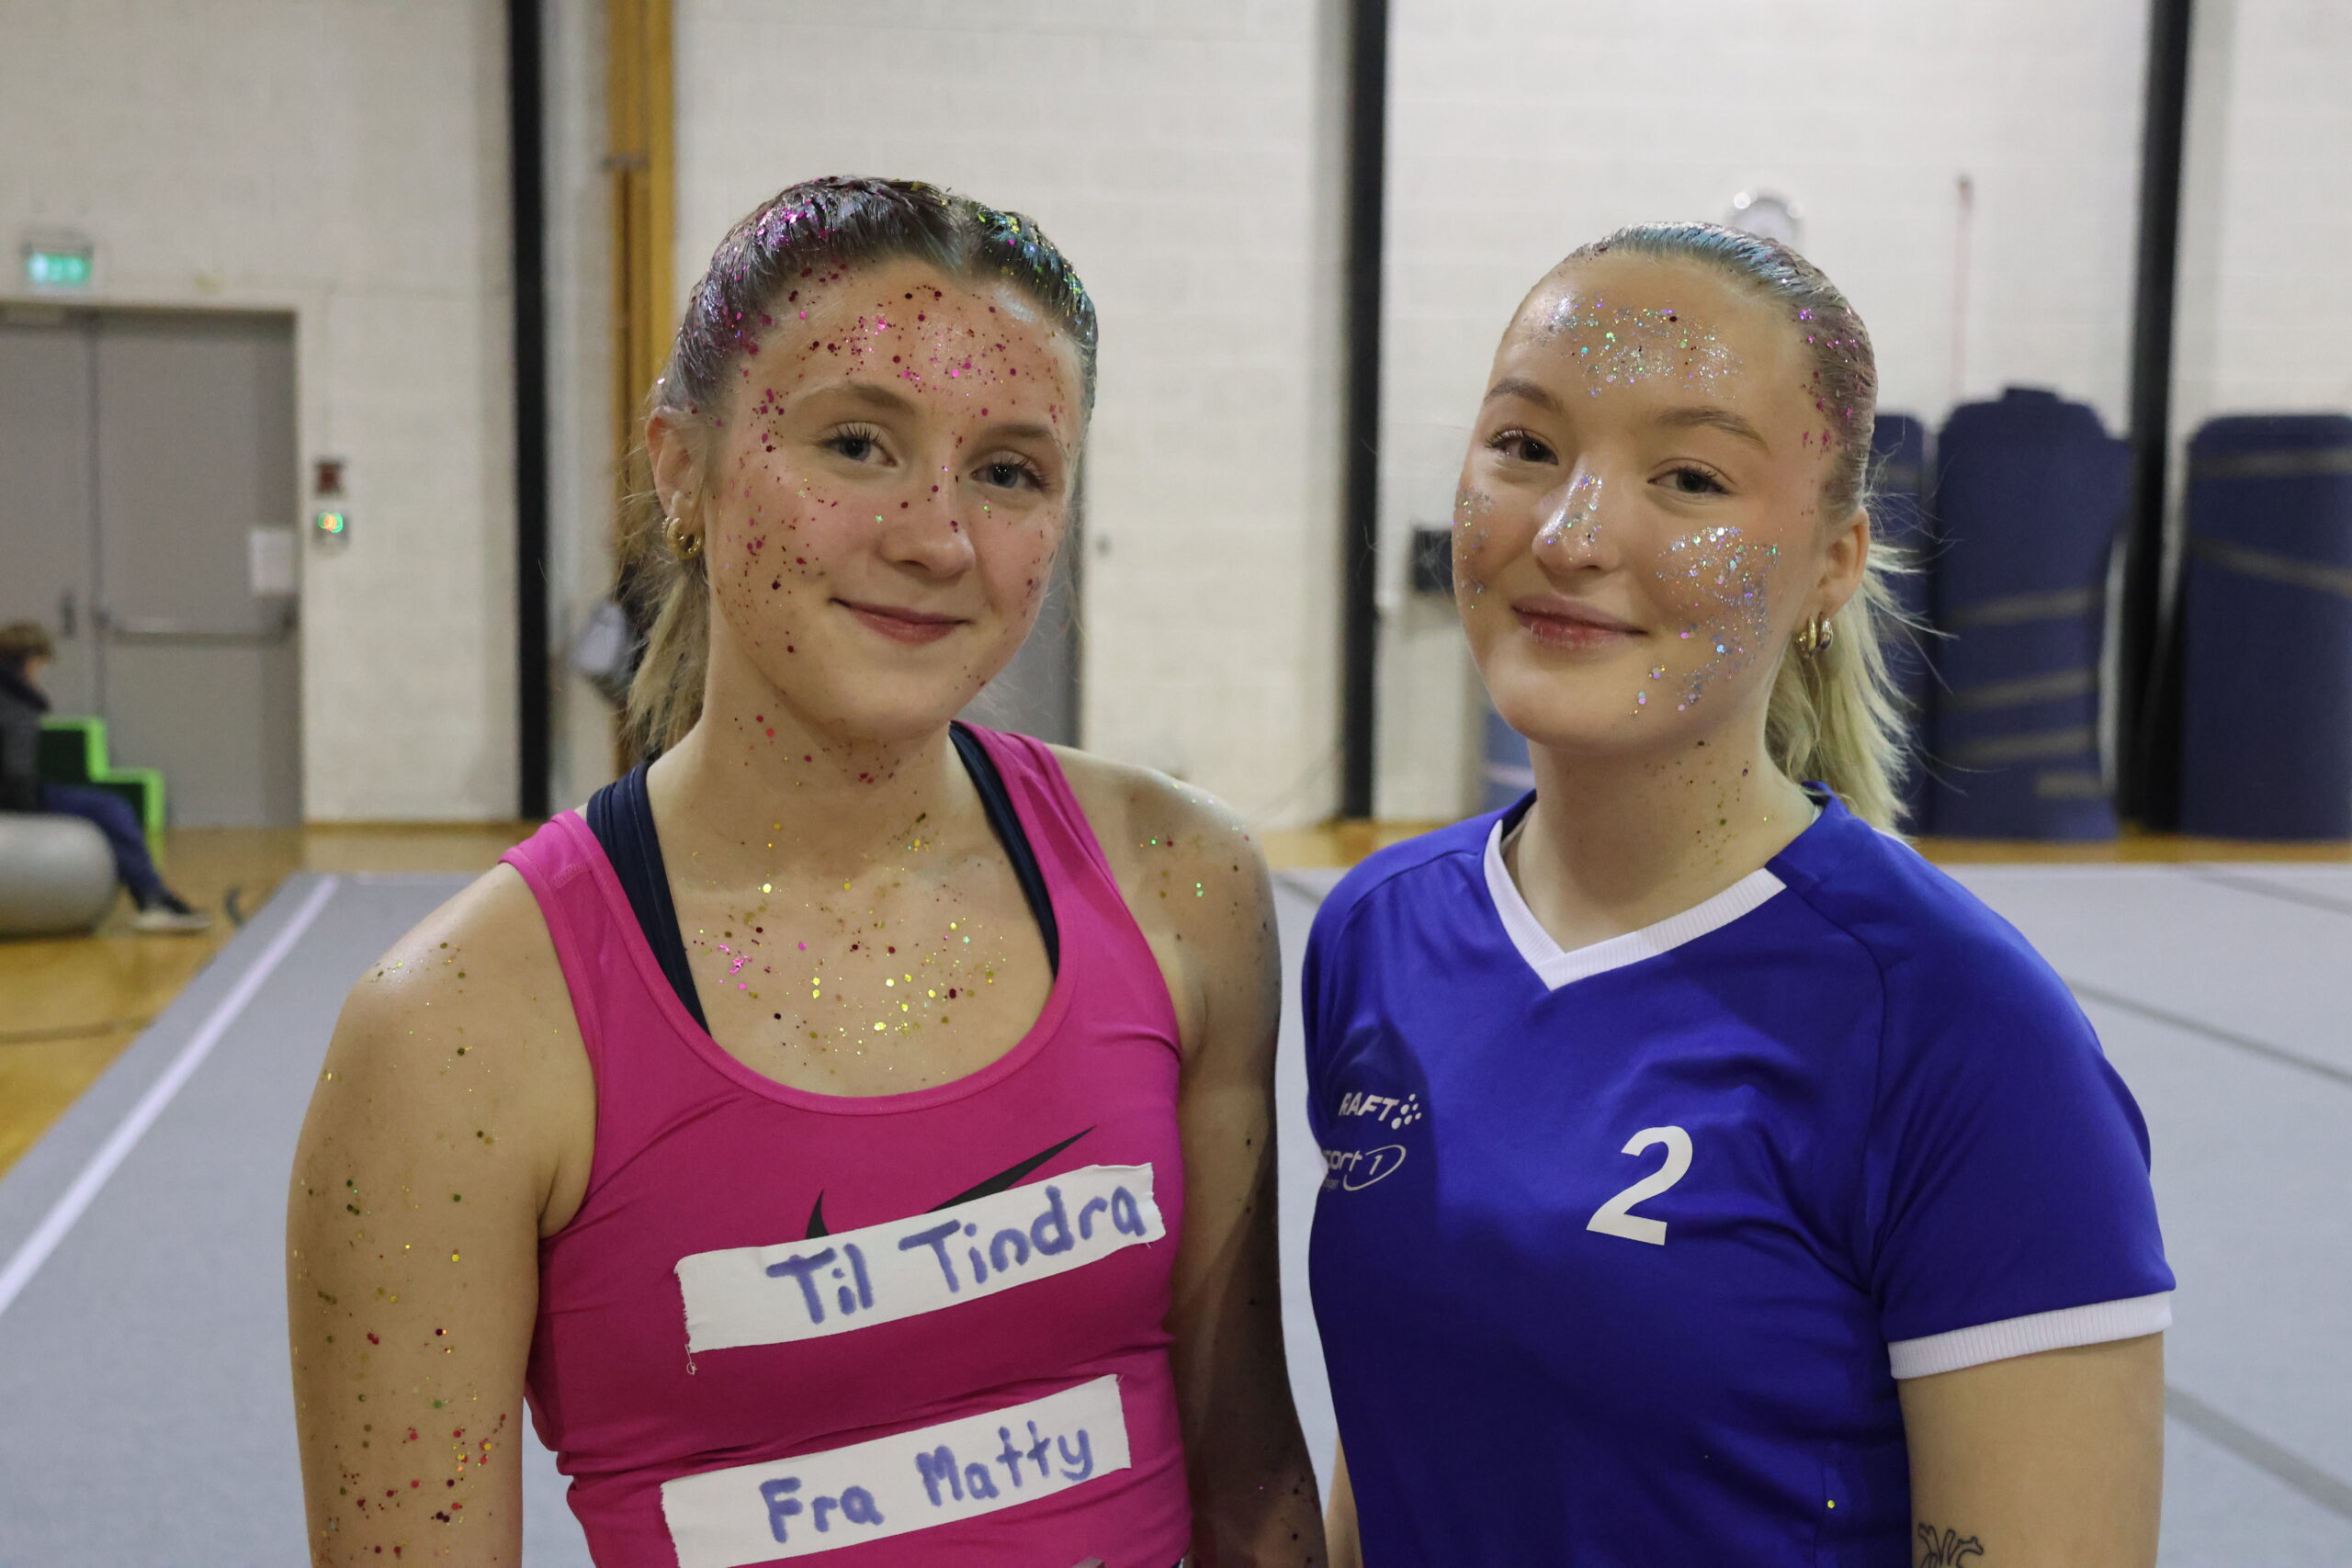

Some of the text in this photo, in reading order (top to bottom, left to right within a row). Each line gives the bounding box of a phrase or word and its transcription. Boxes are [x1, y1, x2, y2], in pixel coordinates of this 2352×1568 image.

[1586, 1125, 1693, 1246] 2
[766, 1186, 1148, 1325] Til Tindra
[759, 1420, 1093, 1543] Fra Matty
